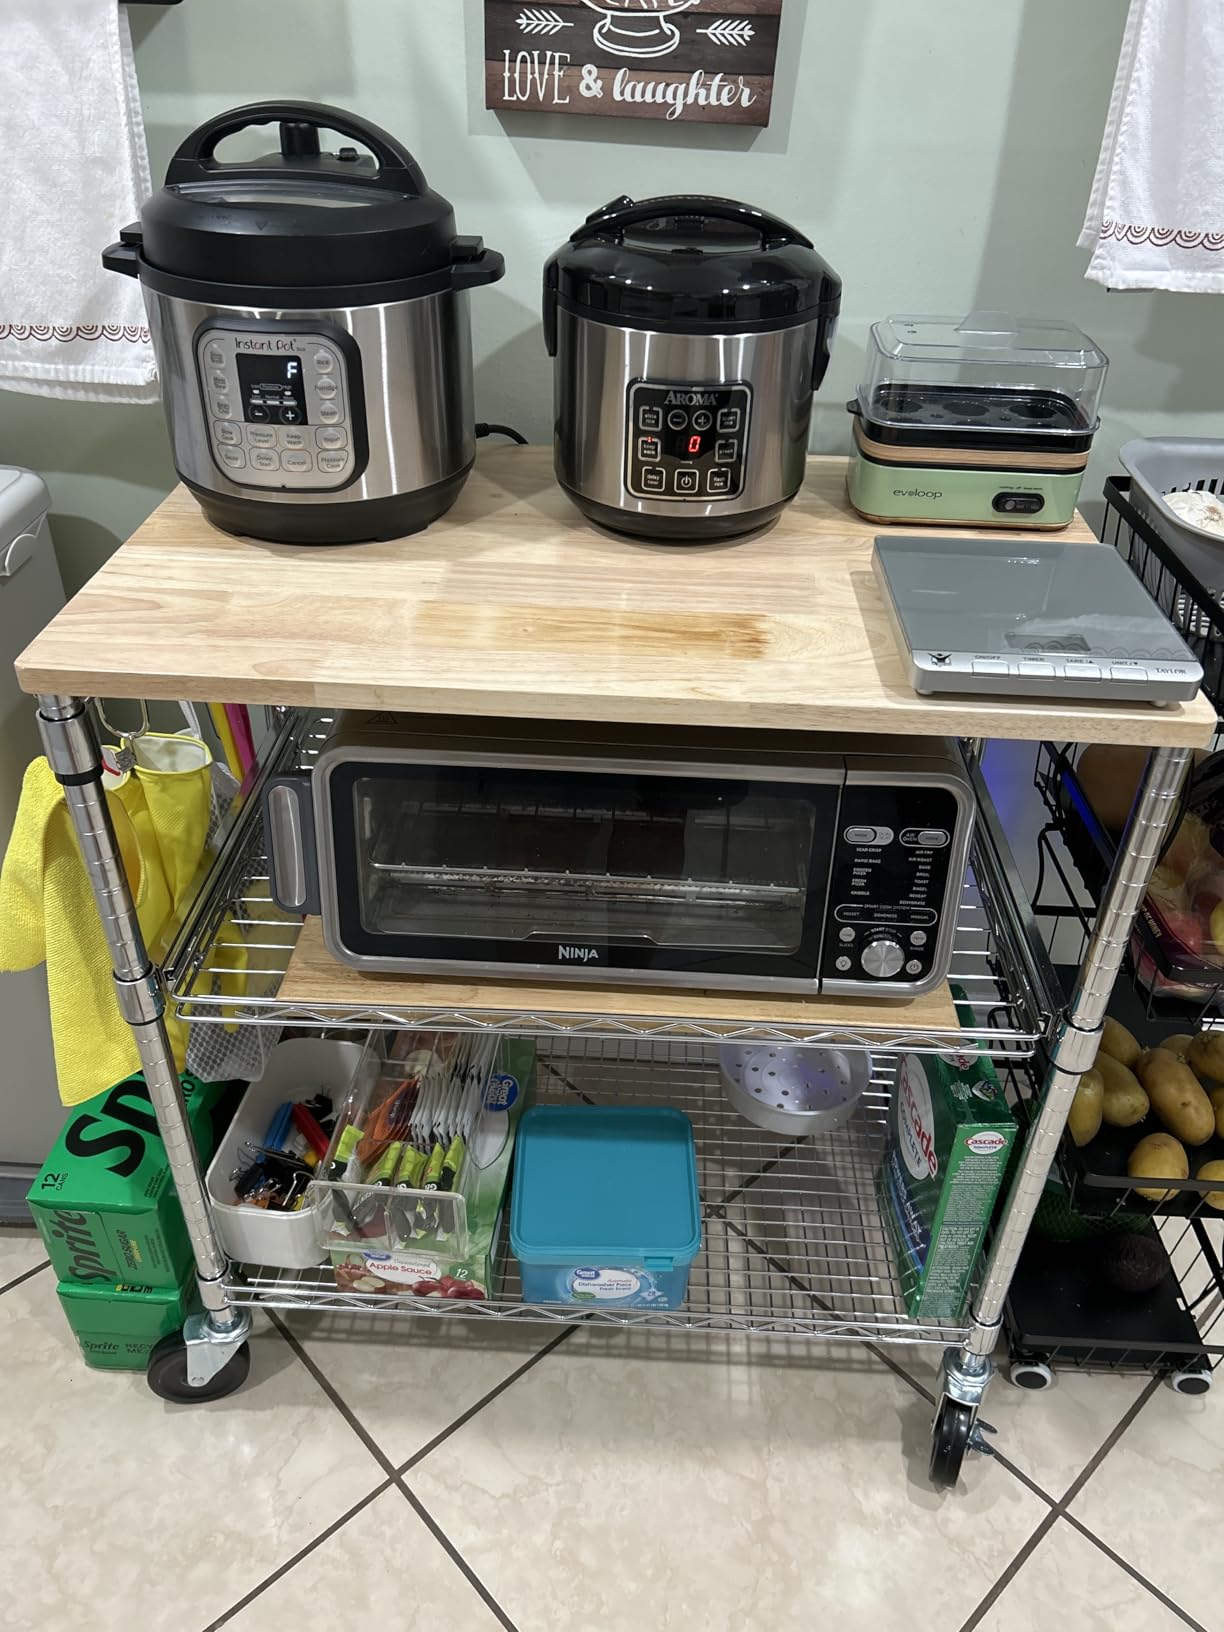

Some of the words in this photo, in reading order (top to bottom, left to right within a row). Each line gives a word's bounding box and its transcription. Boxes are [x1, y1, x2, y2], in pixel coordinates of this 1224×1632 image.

[502, 49, 570, 104] LOVE
[579, 63, 603, 98] &
[612, 67, 757, 120] laughter
[234, 337, 272, 351] Instant
[276, 338, 296, 351] Pot
[287, 362, 298, 378] F
[664, 391, 718, 406] AROMA
[688, 435, 701, 453] 0
[558, 945, 599, 962] NINJA
[497, 1079, 514, 1106] Great
[65, 1070, 160, 1178] Sp
[41, 1173, 61, 1190] 12
[55, 1173, 69, 1191] CANS
[49, 1210, 118, 1281] Sprite
[369, 1262, 399, 1271] Apple
[400, 1266, 432, 1275] Sauce
[455, 1268, 468, 1279] 12
[84, 1340, 120, 1351] Sprite
